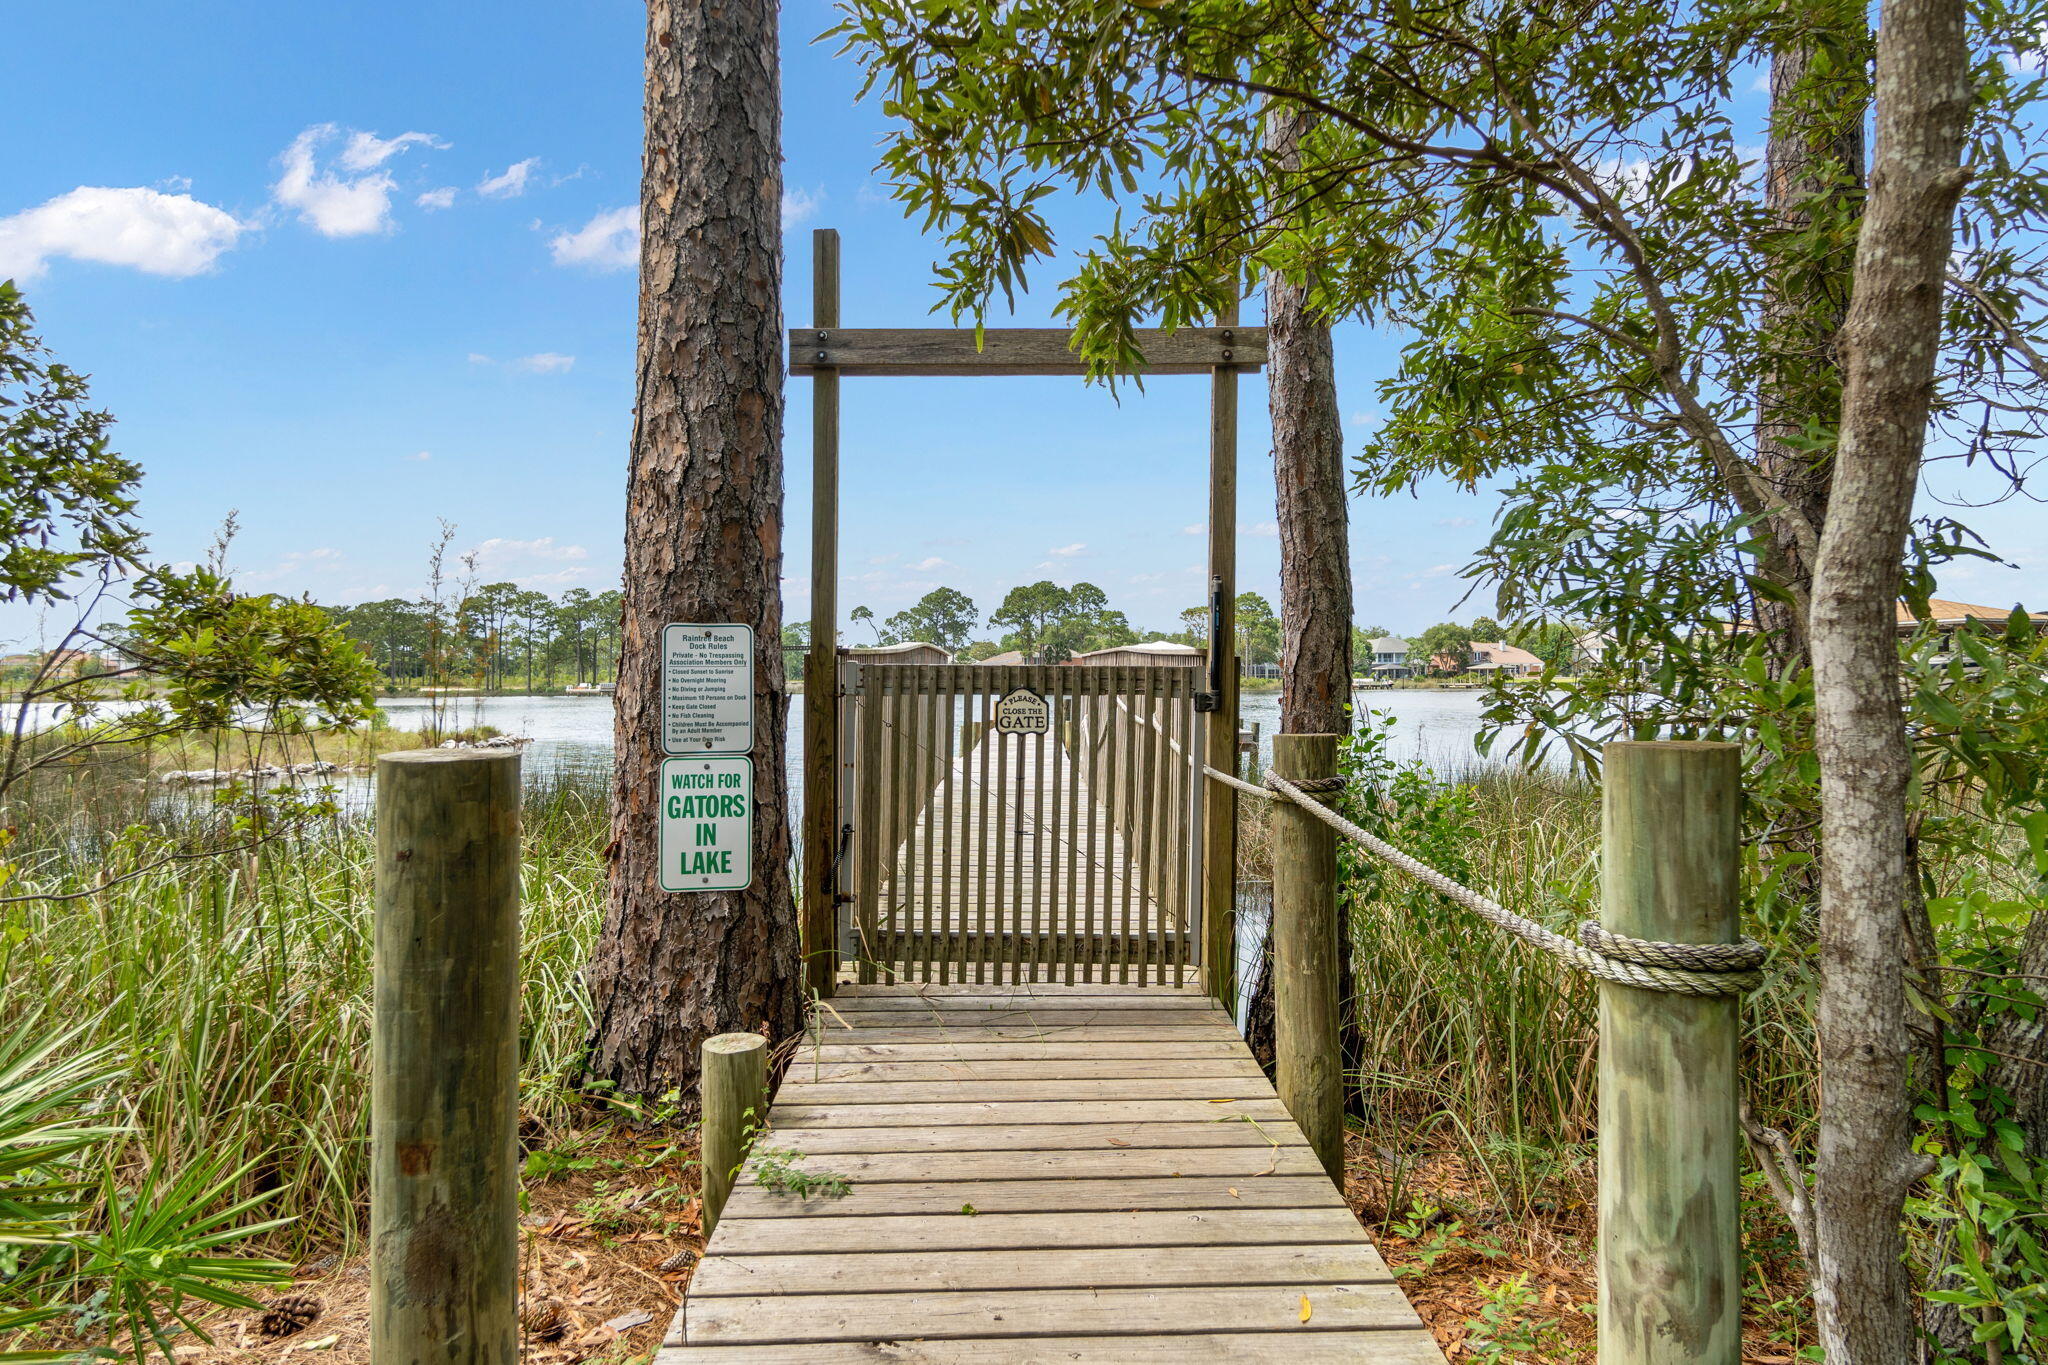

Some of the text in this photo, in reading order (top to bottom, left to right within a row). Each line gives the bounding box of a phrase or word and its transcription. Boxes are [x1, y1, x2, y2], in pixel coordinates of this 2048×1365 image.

[1009, 696, 1037, 704] PLEASE
[1000, 716, 1045, 728] GATE
[672, 774, 741, 789] WATCH FOR
[668, 794, 745, 819] GATORS
[696, 823, 716, 846] IN
[681, 851, 732, 874] LAKE
